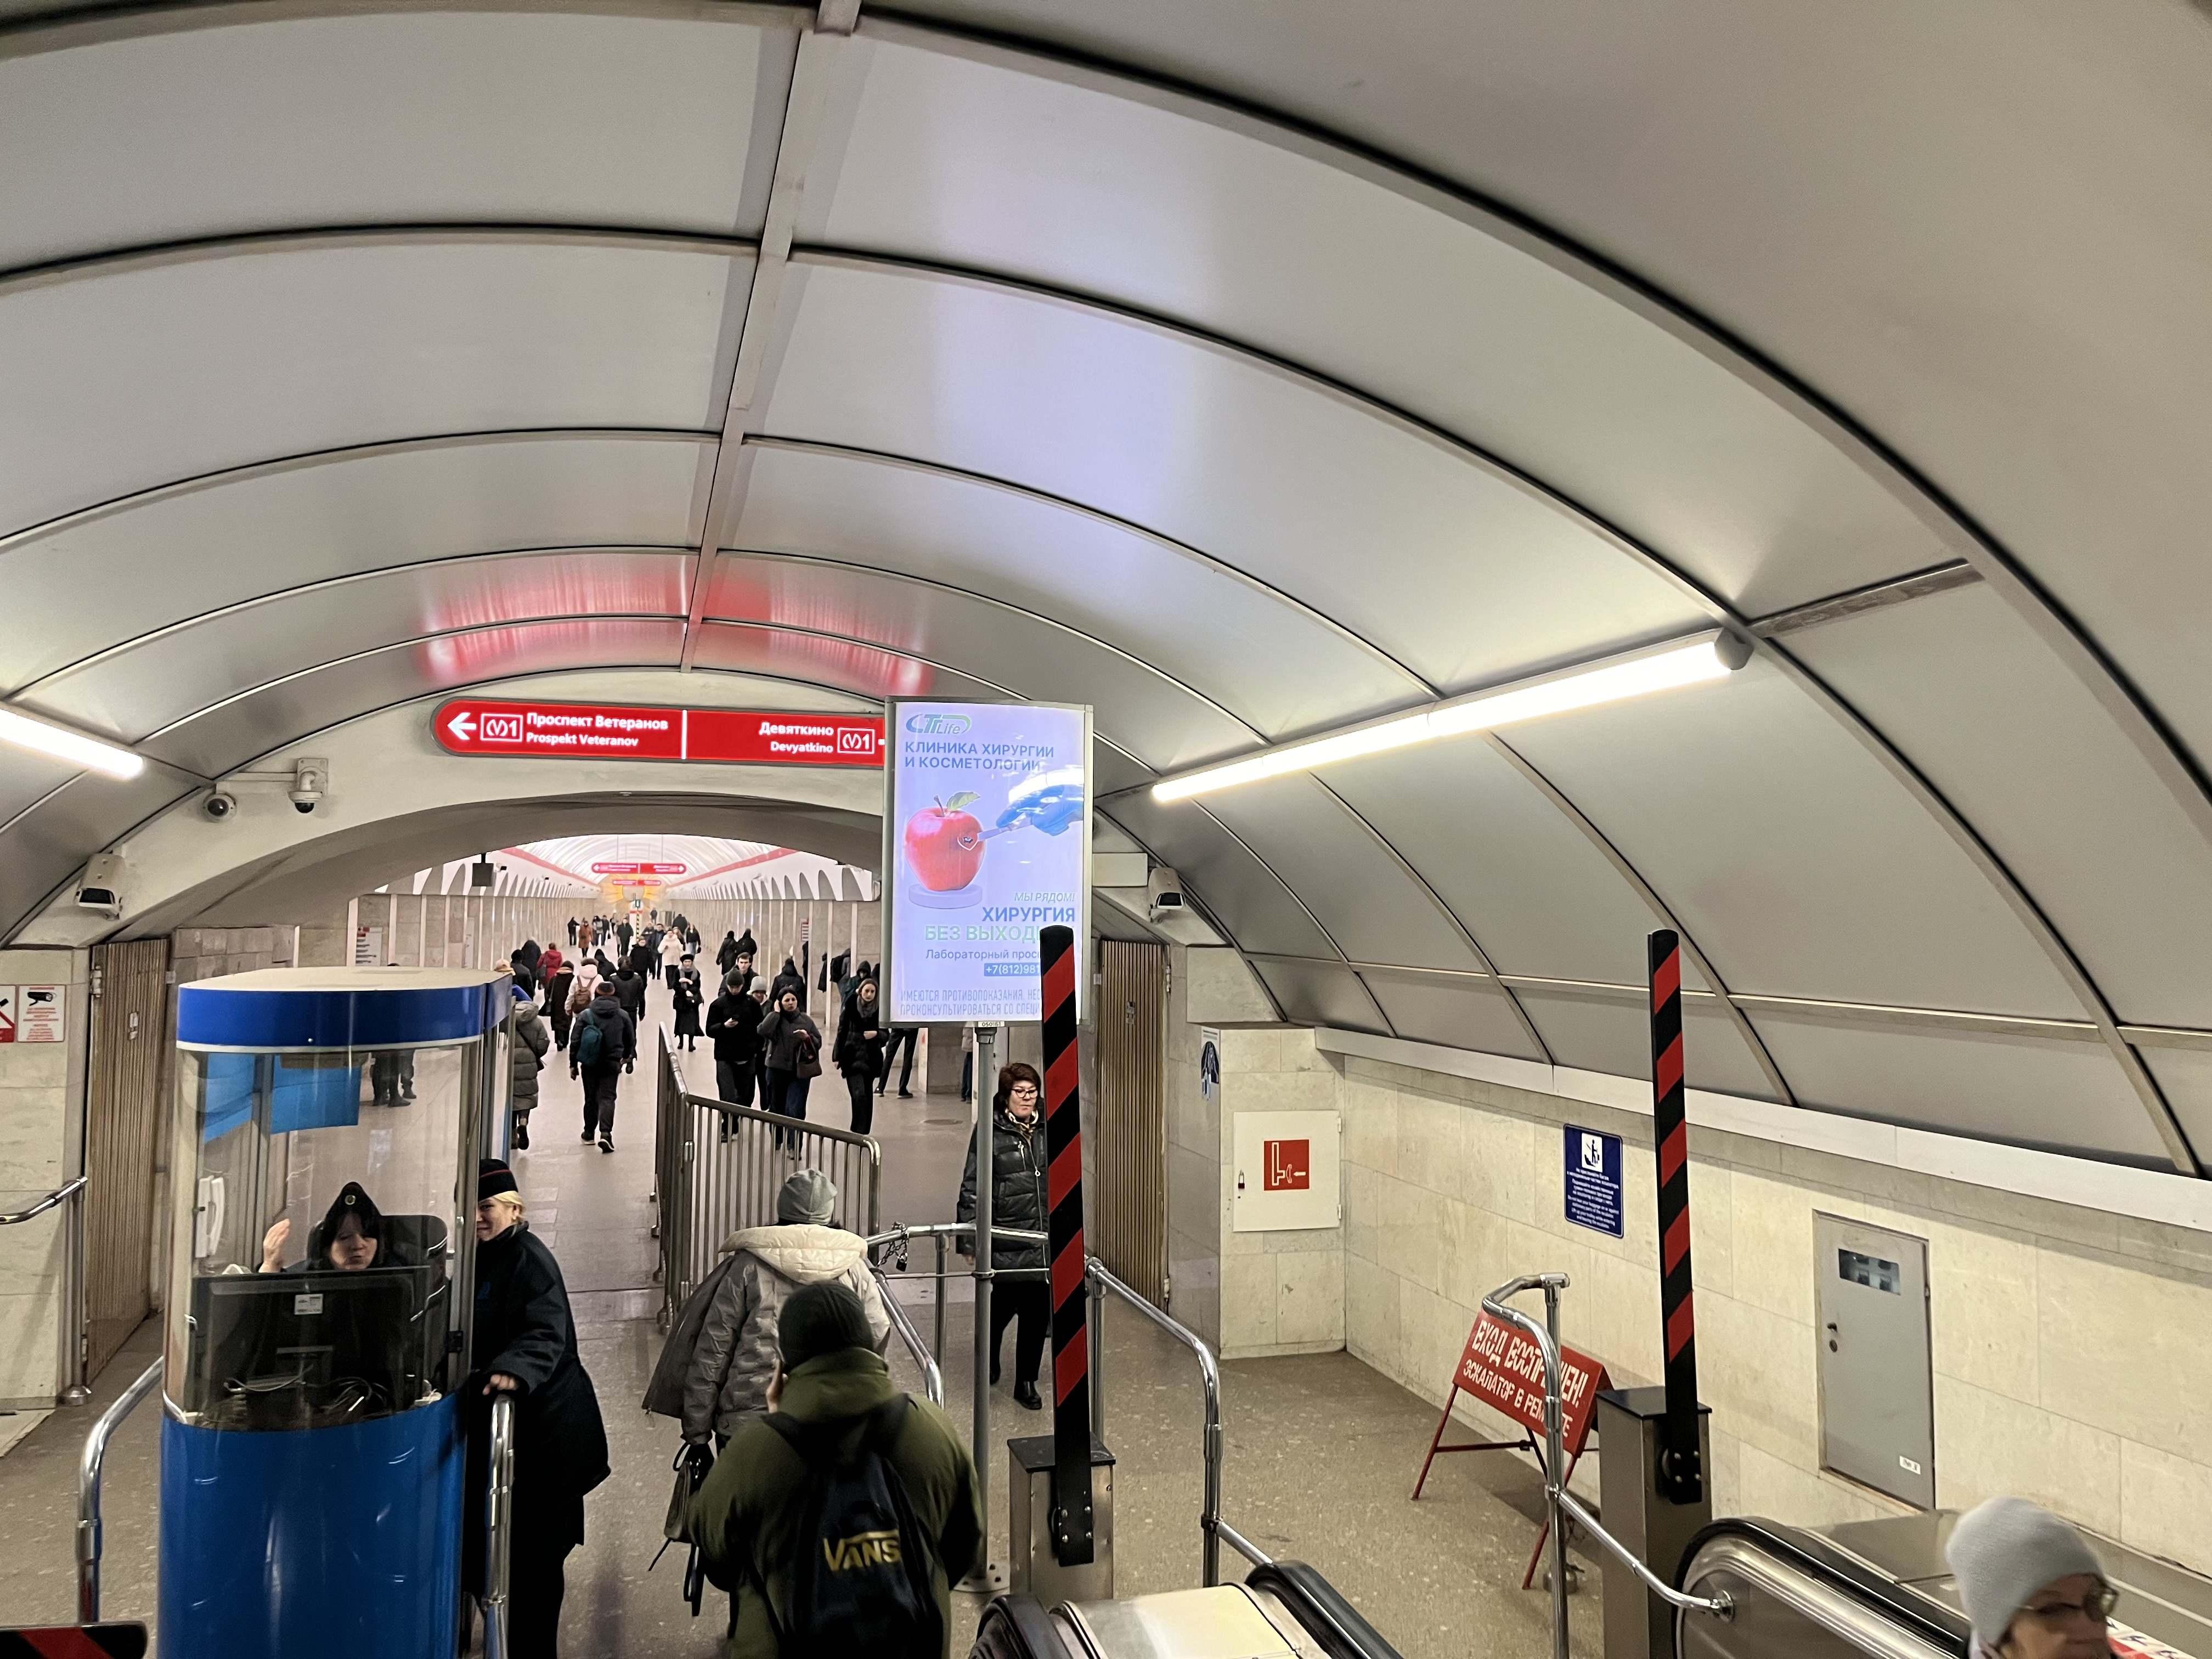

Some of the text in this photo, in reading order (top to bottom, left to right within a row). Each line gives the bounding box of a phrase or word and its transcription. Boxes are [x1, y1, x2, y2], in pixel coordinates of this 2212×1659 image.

[527, 713, 668, 731] Проспект Ветеранов
[759, 722, 834, 736] Девяткино
[527, 732, 639, 747] Prospekt Veteranov
[770, 741, 834, 754] Devyatkino
[905, 742, 1054, 758] КЛИНИКА ХИРУРГИИ
[905, 757, 1041, 771] И КОСМЕТОЛОГИИ
[1014, 892, 1075, 903] МЫ РЯДОМ!
[981, 907, 1075, 922] ХИРУРГИЯ
[926, 925, 1040, 944] БЕЗ ВЫХОД
[926, 949, 1040, 961] Лабораторный прос
[986, 964, 1040, 975] +7(812)981
[901, 990, 939, 1002] ИМЕЮТСЯ
[900, 1003, 1040, 1016] ПРОКОНСУЛЬТИРОВАТЬСЯ СО СПЕЦИ
[1471, 1319, 1589, 1408] ВХОД ВОСПРЕН!
[1463, 1359, 1573, 1438] ЭСКАЛАТОР В РЕМЕ
[823, 1528, 902, 1572] VANS
